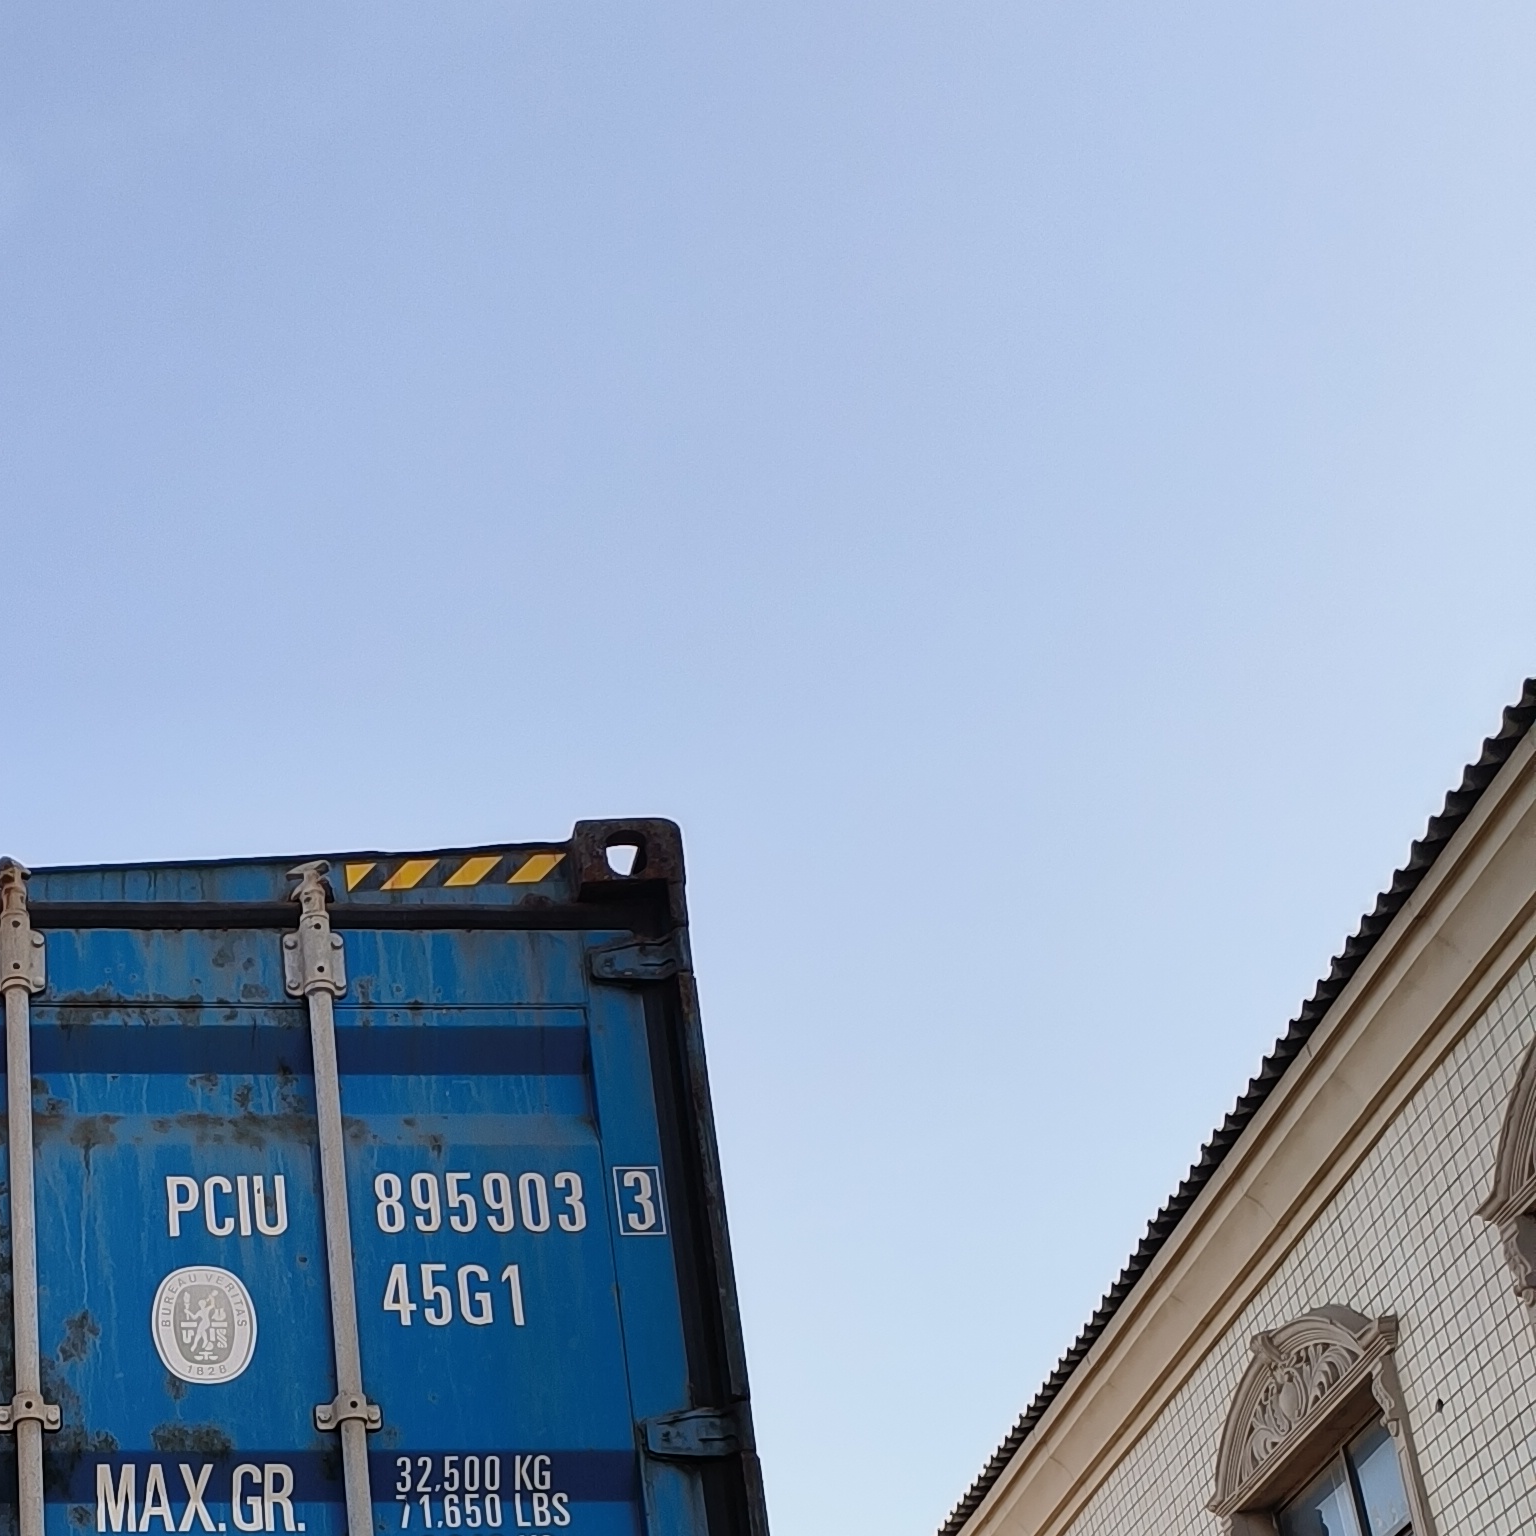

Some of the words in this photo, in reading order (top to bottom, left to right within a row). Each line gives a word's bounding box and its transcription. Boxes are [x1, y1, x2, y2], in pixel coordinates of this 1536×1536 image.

[166, 1174, 288, 1237] PCIU
[374, 1171, 588, 1233] 895903
[623, 1171, 656, 1231] 3
[161, 1273, 198, 1328] BUREAU
[205, 1273, 248, 1328] VERITAS
[383, 1263, 526, 1326] 45G1
[187, 1364, 228, 1376] 1828
[396, 1455, 500, 1492] 32,500
[514, 1454, 551, 1491] KG
[396, 1493, 502, 1529] 71,650
[515, 1492, 571, 1527] LBS
